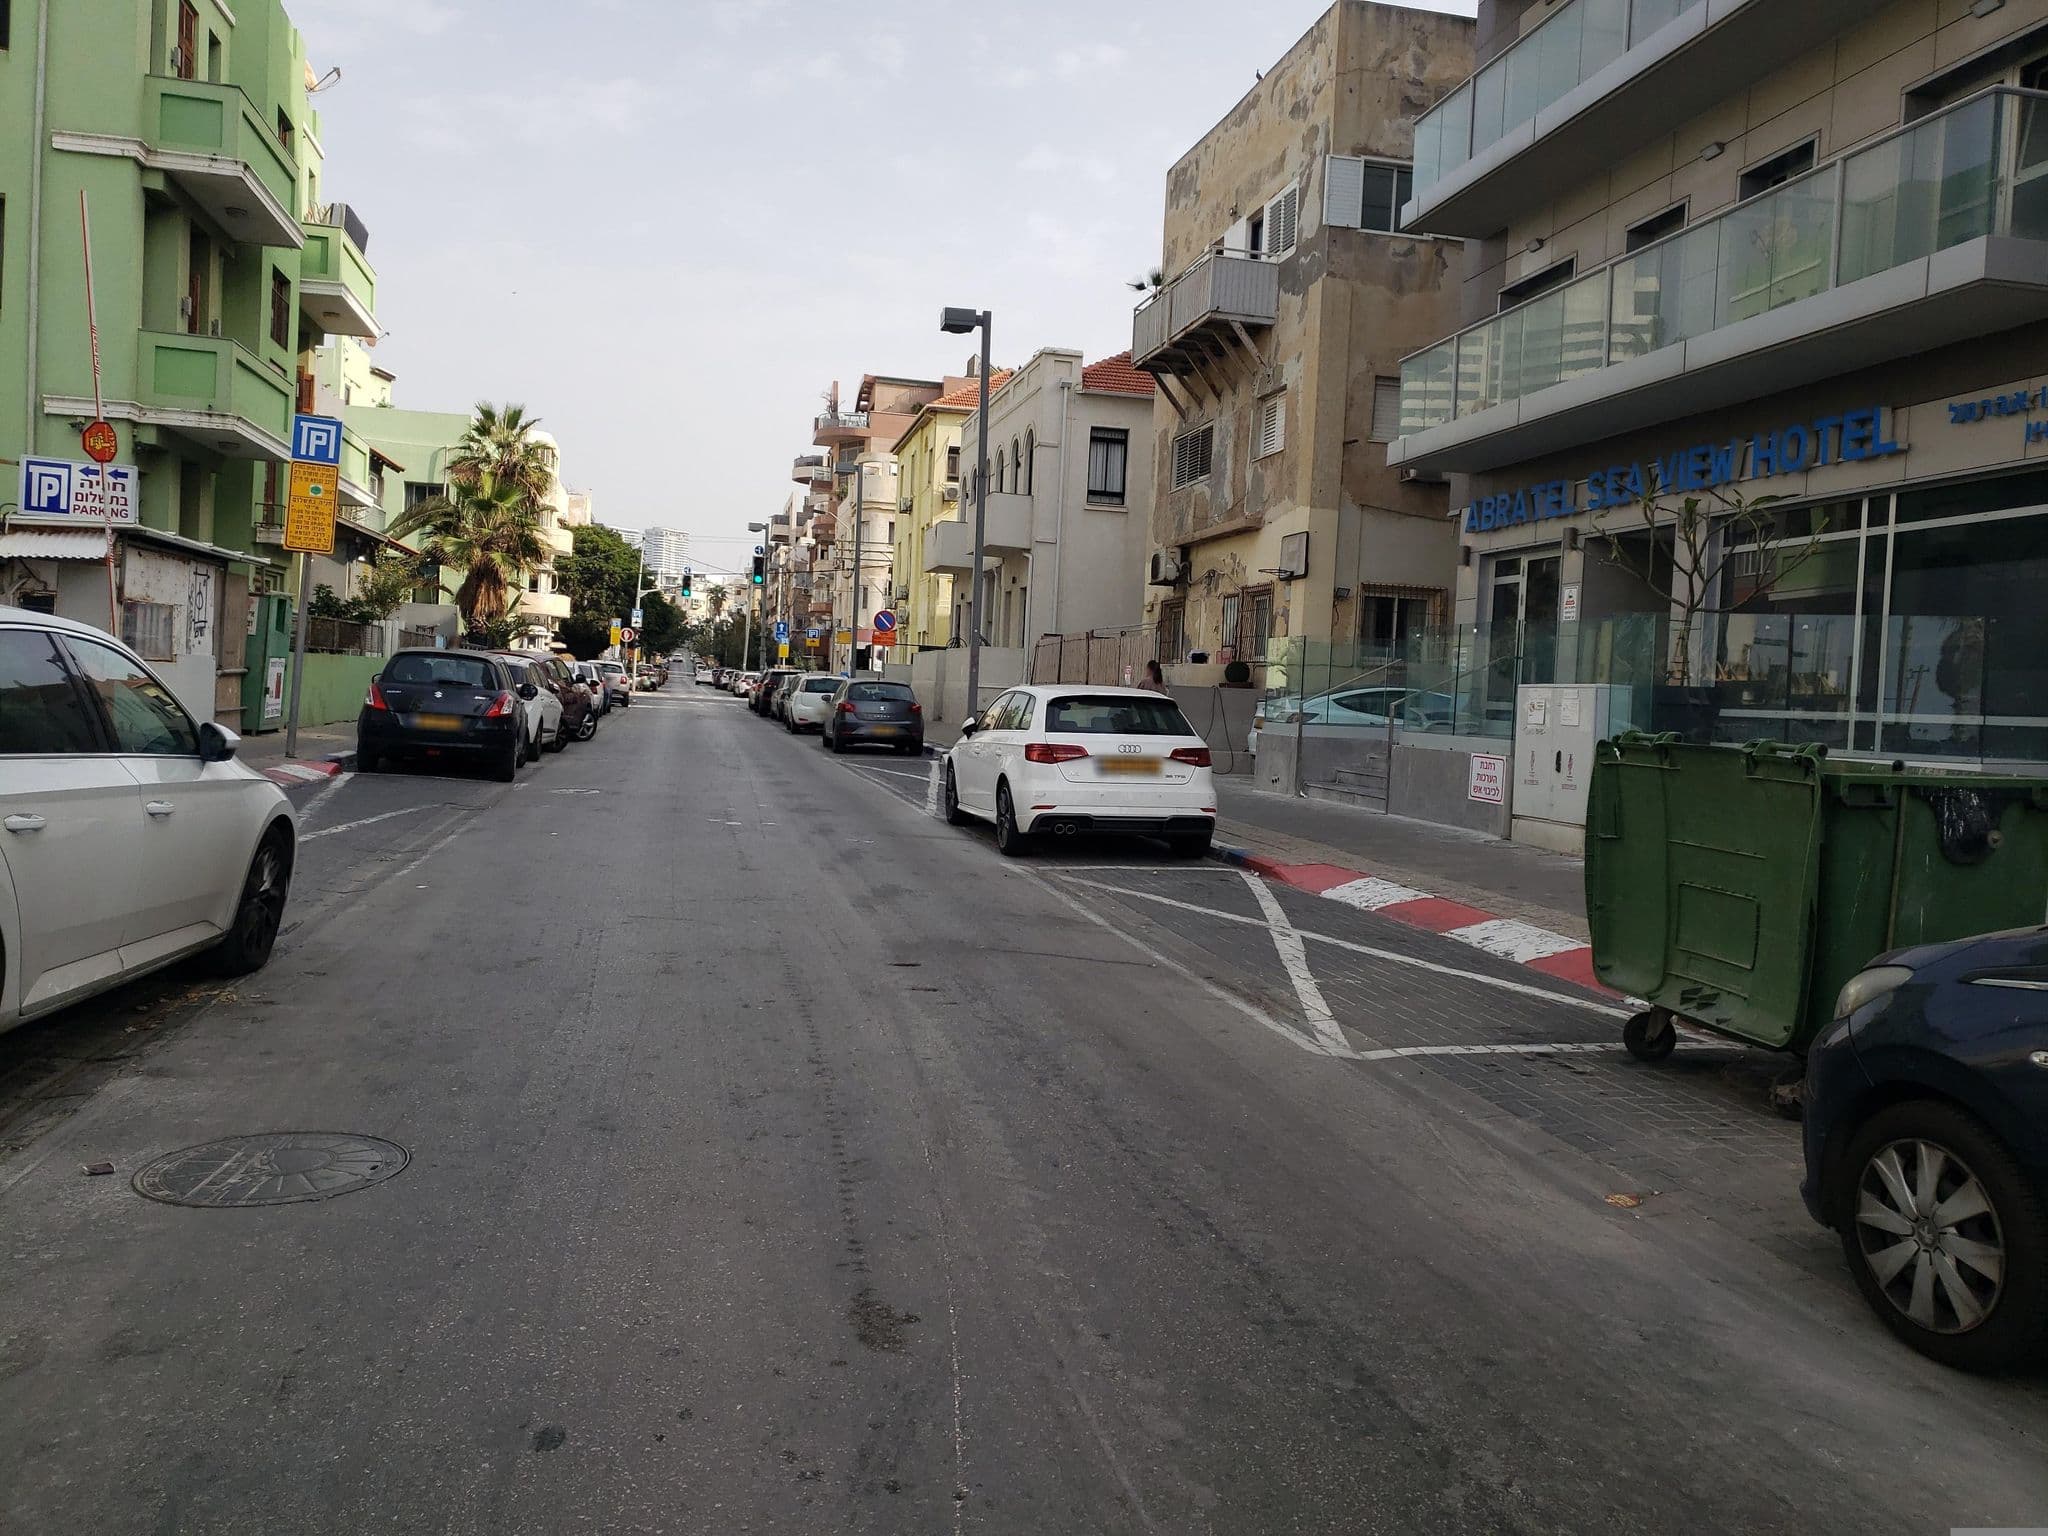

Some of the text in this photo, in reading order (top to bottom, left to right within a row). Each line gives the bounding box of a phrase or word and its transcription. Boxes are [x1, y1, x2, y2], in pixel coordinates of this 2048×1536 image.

[1465, 406, 1898, 533] ABRATEL SEA VIEW HOTEL
[80, 478, 127, 492] חיה
[73, 504, 129, 519] PARKNG
[1480, 760, 1496, 771] רחבת
[1473, 785, 1483, 794] אש
